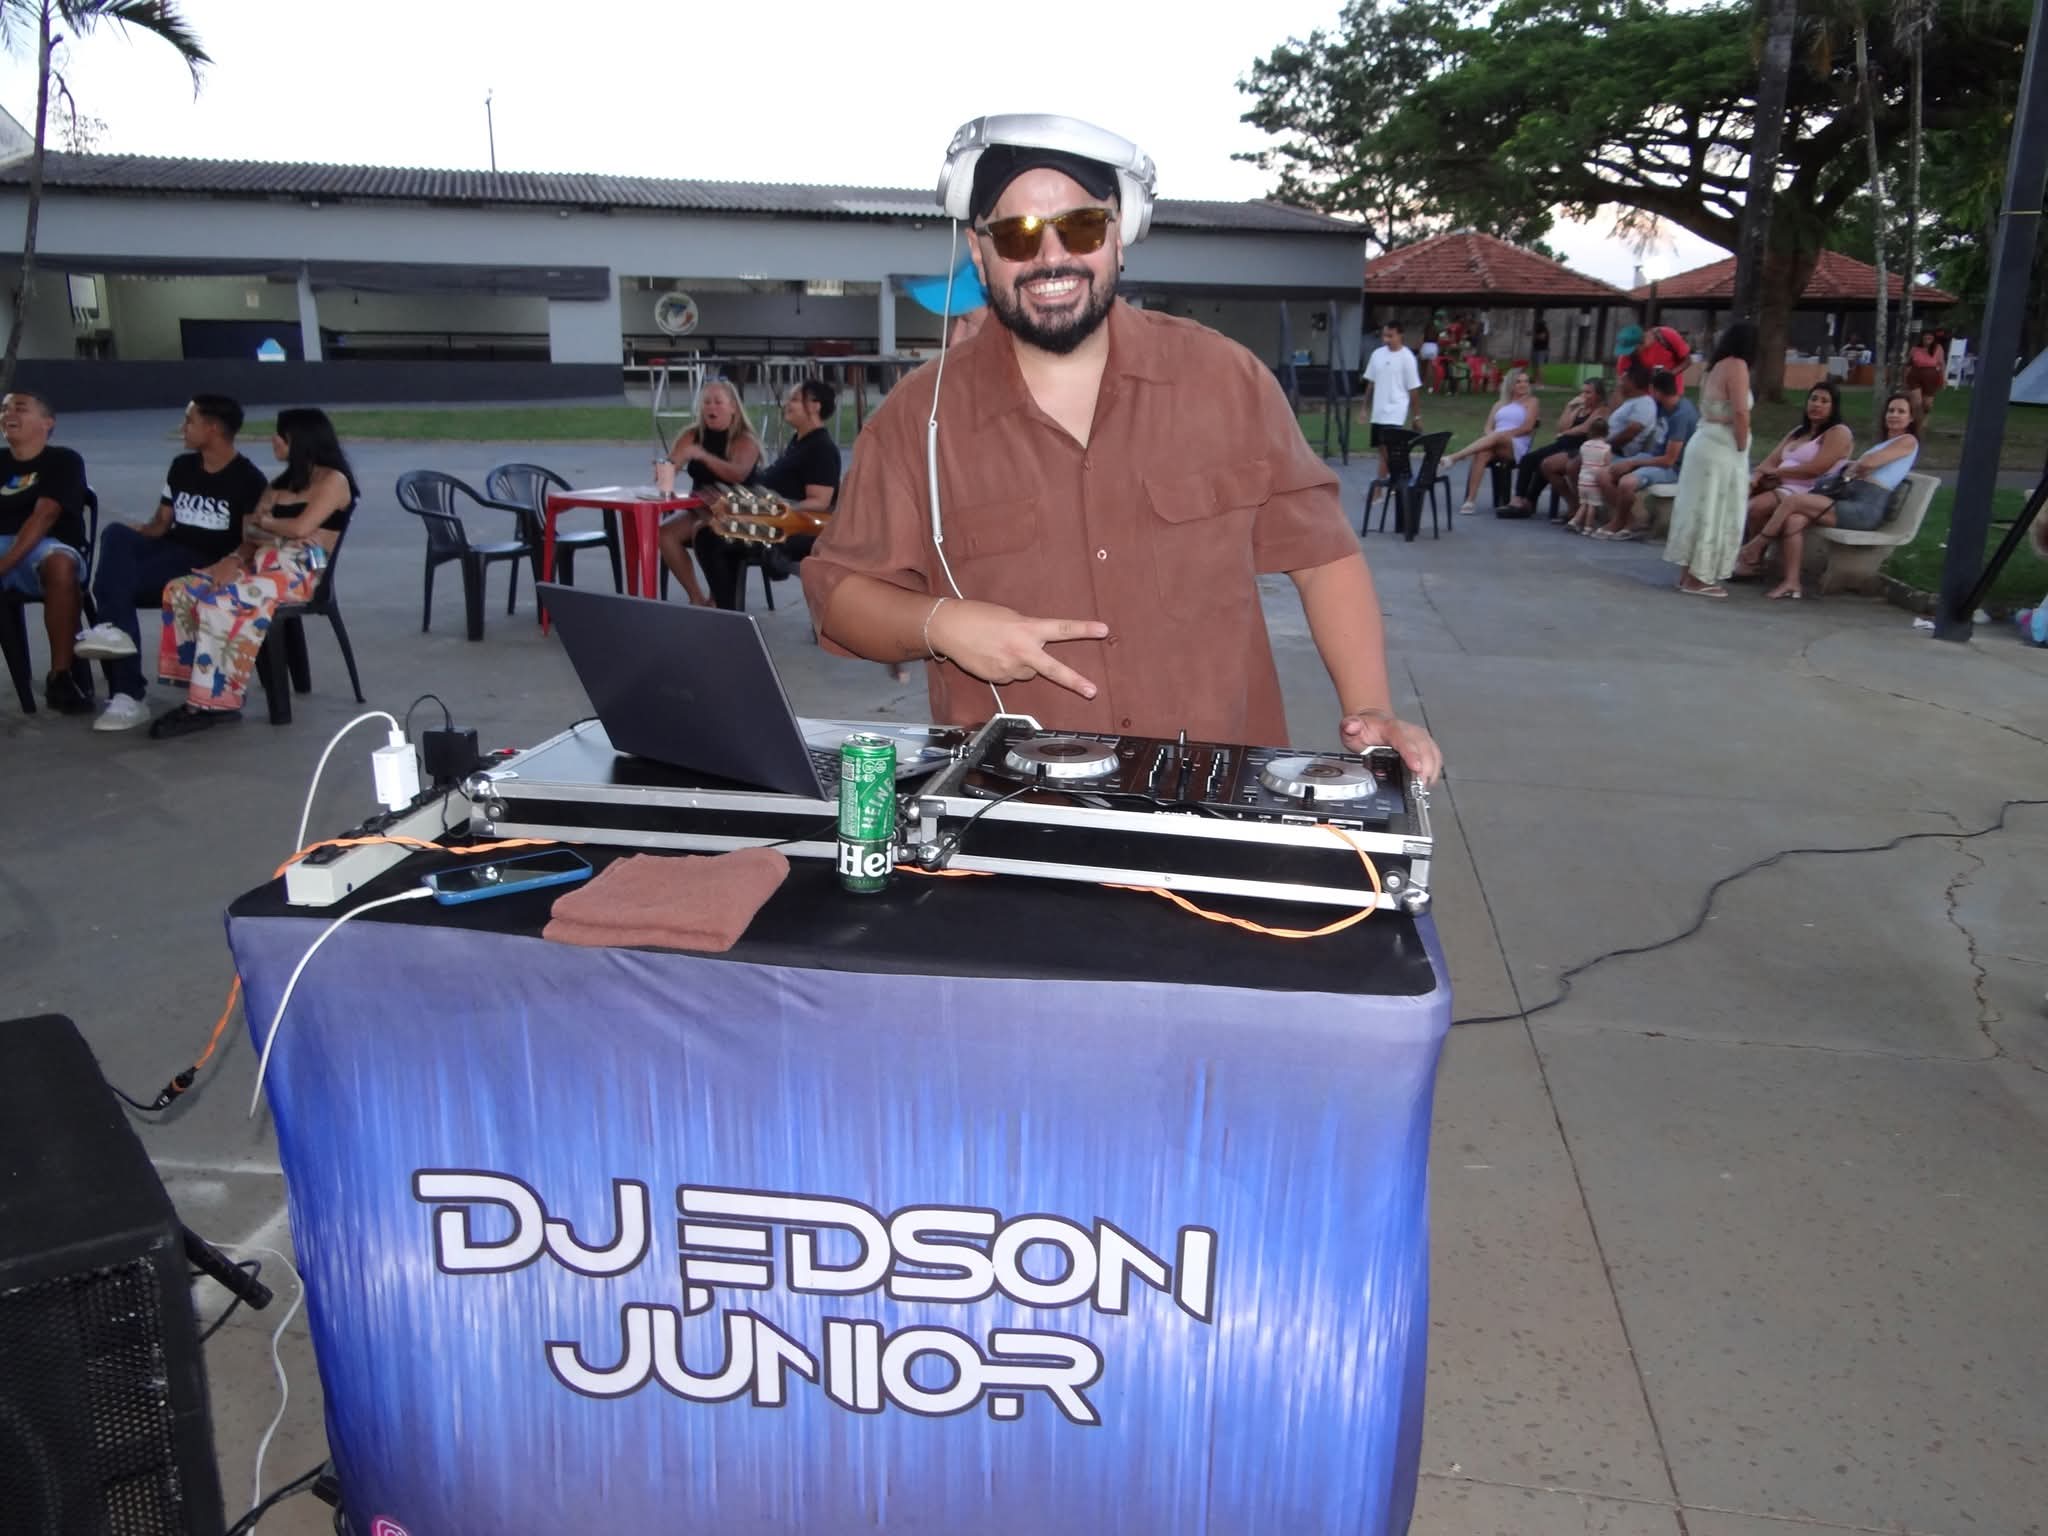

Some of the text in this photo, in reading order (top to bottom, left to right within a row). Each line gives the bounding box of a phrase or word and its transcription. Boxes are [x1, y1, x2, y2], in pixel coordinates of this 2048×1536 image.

[176, 491, 230, 519] BOSS
[412, 1168, 1218, 1323] DJ EDSON
